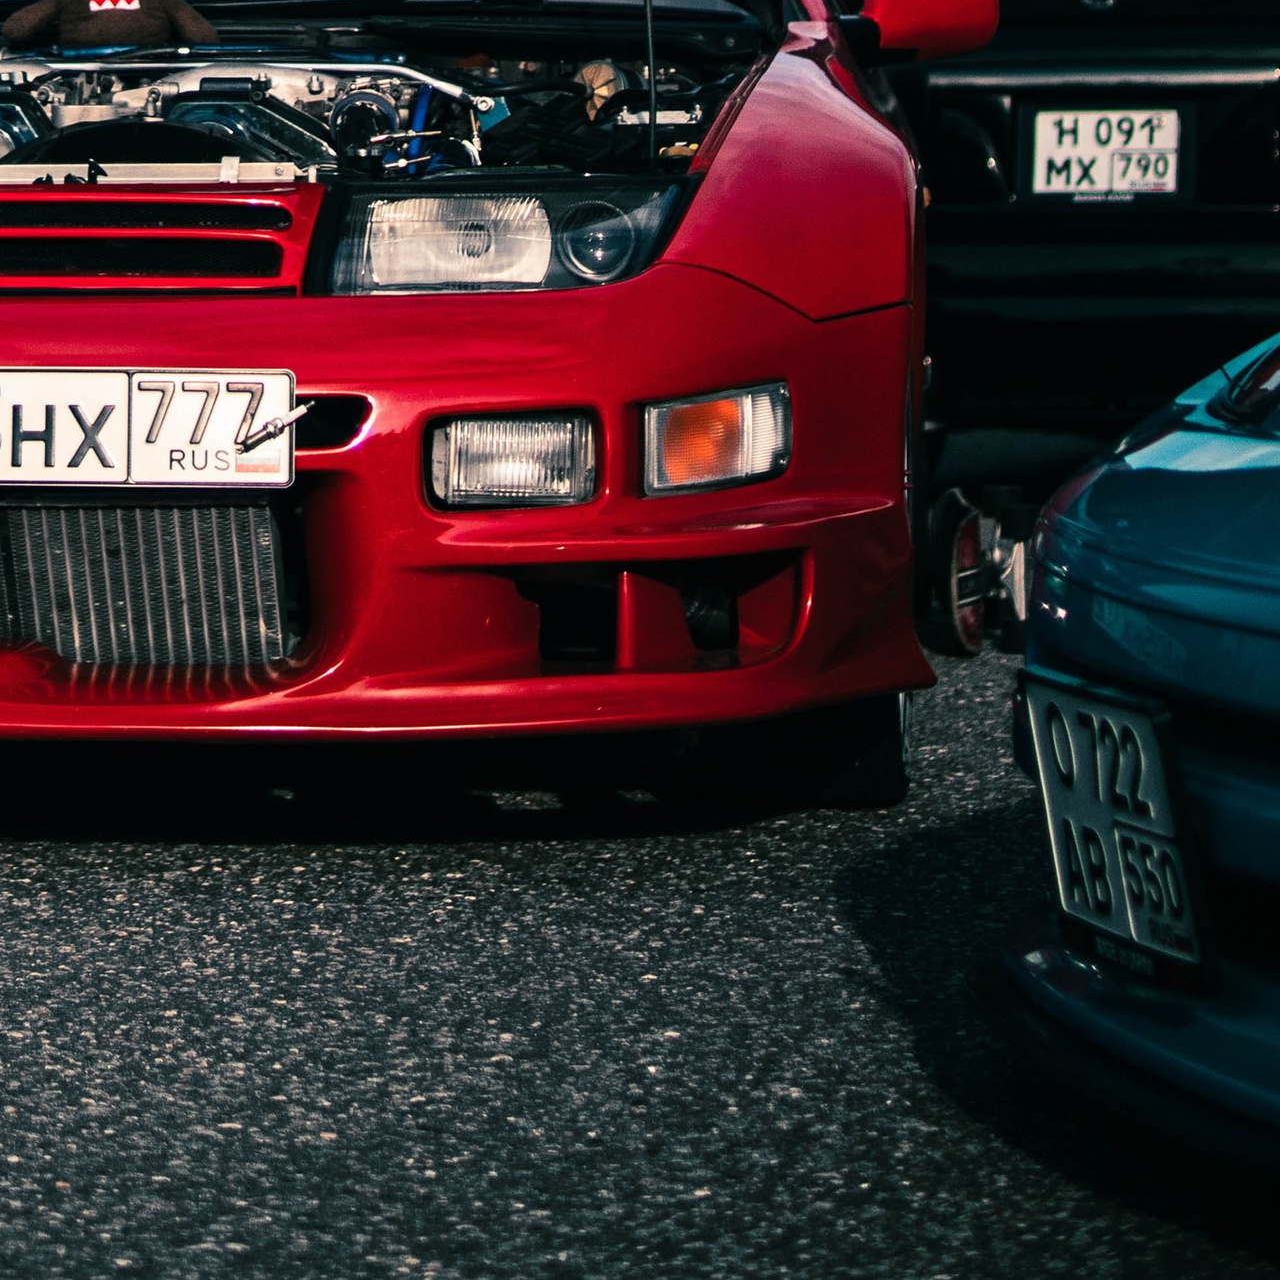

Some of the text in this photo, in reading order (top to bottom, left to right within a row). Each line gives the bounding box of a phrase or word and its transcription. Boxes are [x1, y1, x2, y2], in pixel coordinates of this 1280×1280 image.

[1095, 117, 1155, 146] 091
[1046, 153, 1169, 186] MX 790
[138, 380, 265, 446] 777
[169, 449, 231, 471] RUS
[1076, 709, 1155, 820] 722
[1064, 816, 1184, 920] AB 550
